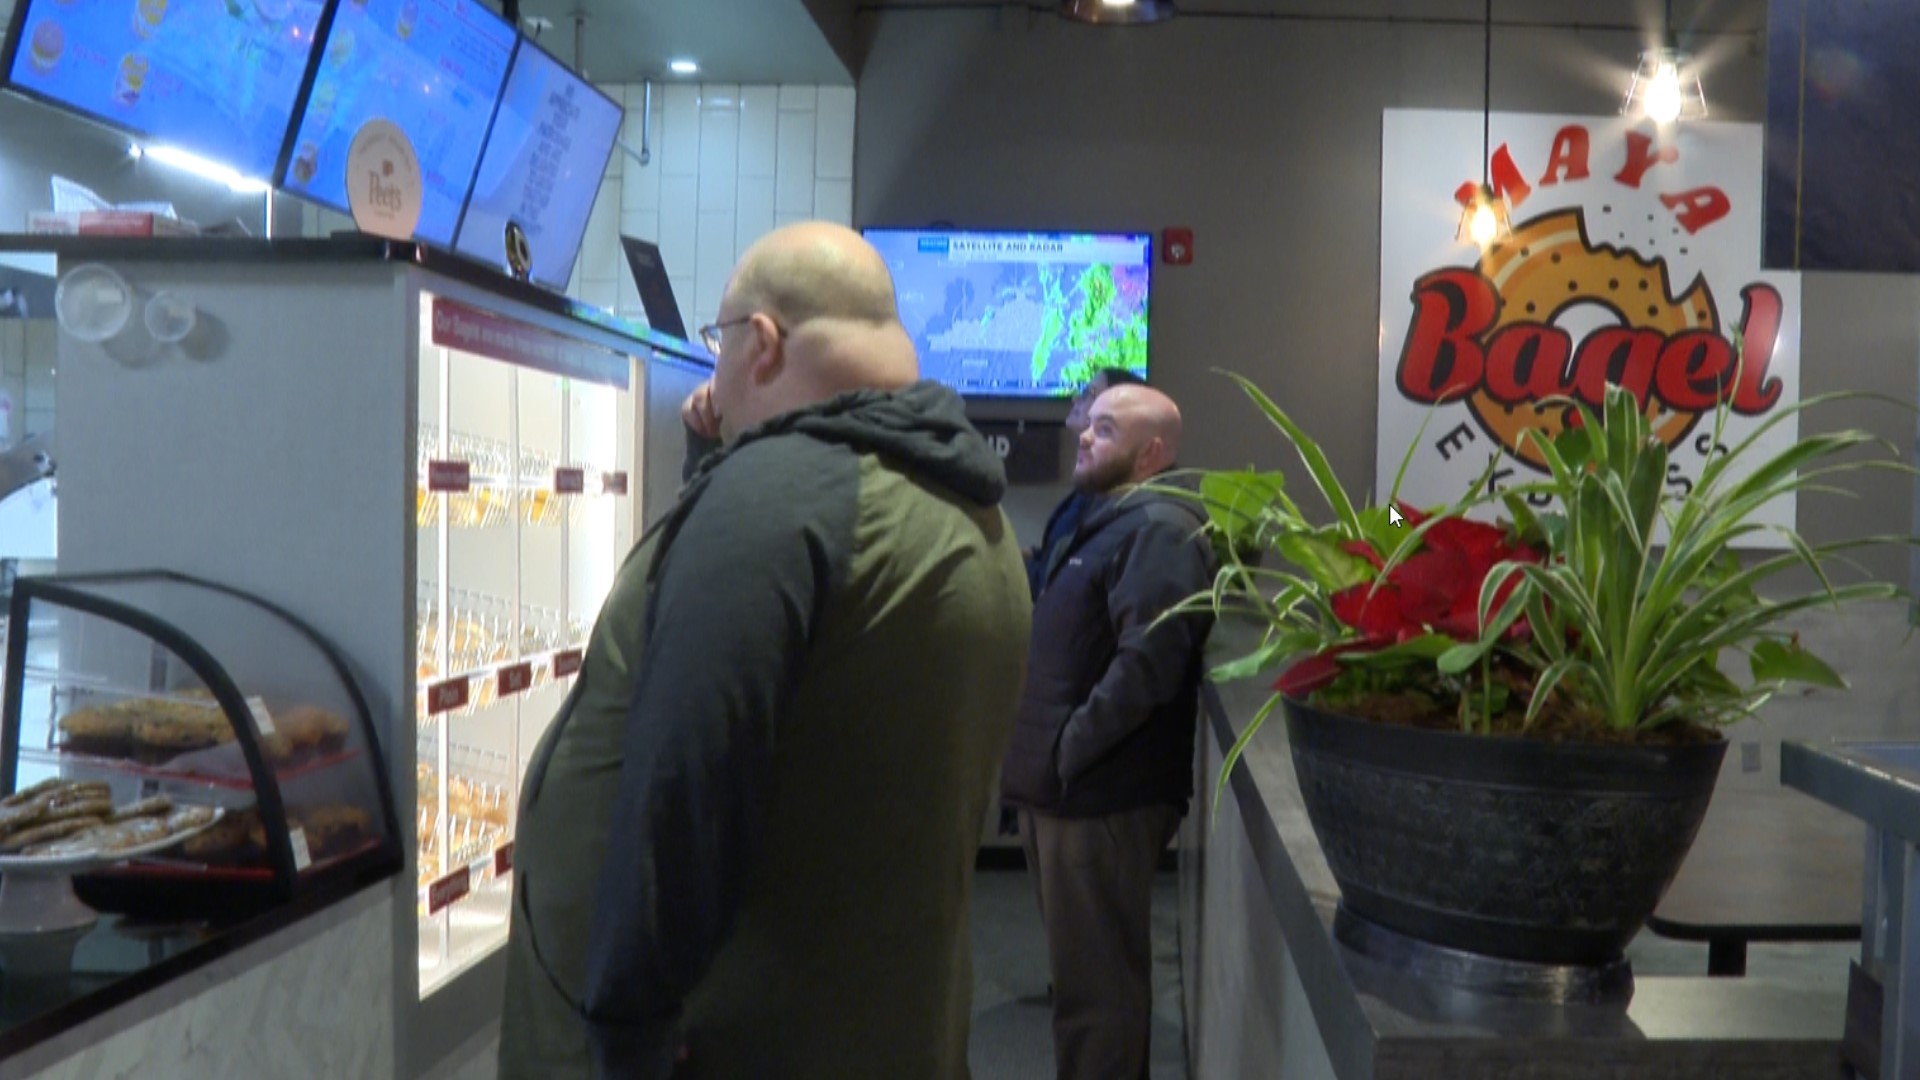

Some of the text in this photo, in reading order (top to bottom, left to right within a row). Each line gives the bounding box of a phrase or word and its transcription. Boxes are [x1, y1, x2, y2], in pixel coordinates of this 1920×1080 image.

[1455, 124, 1732, 236] MAYA
[952, 240, 1002, 252] SATELLITE
[1006, 241, 1027, 252] AND
[1029, 241, 1063, 253] RADAR
[1395, 266, 1784, 431] Bagel
